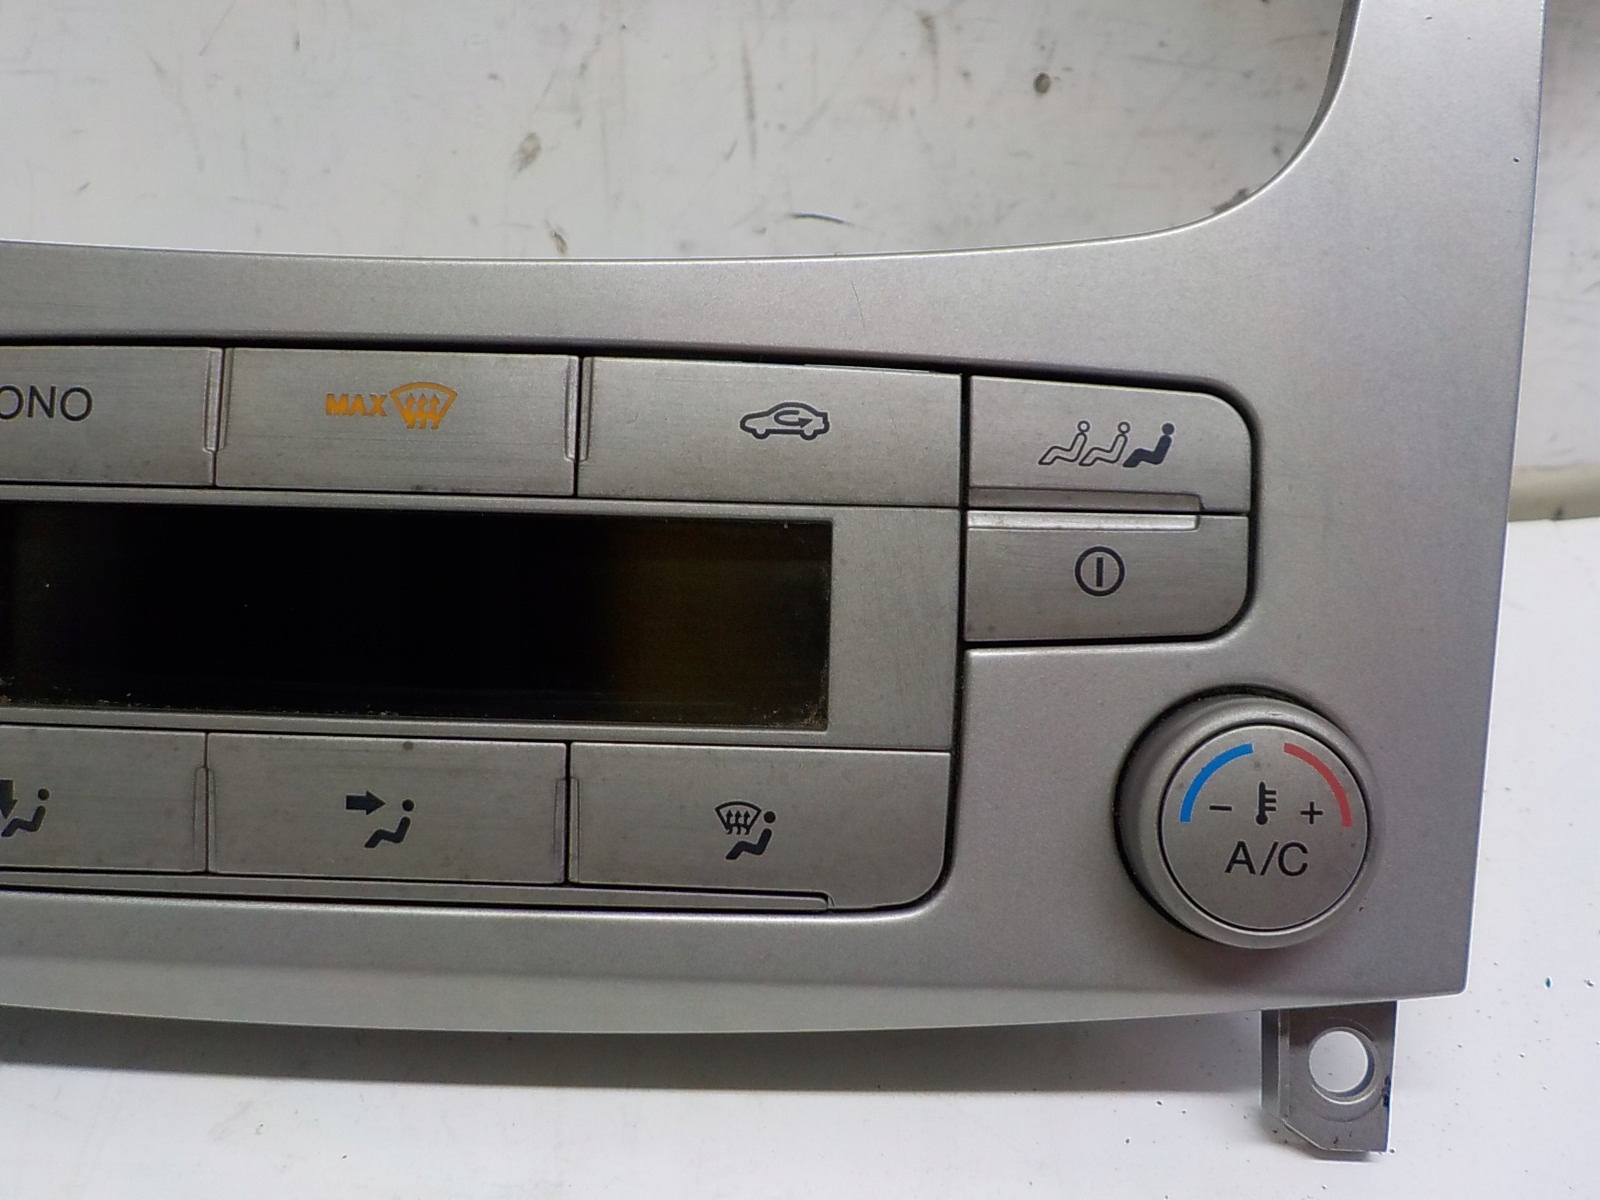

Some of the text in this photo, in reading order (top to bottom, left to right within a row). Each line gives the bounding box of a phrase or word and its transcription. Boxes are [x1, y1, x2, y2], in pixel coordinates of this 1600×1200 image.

[0, 385, 93, 421] ONO
[325, 393, 388, 417] MAX
[1224, 840, 1309, 877] A/C
